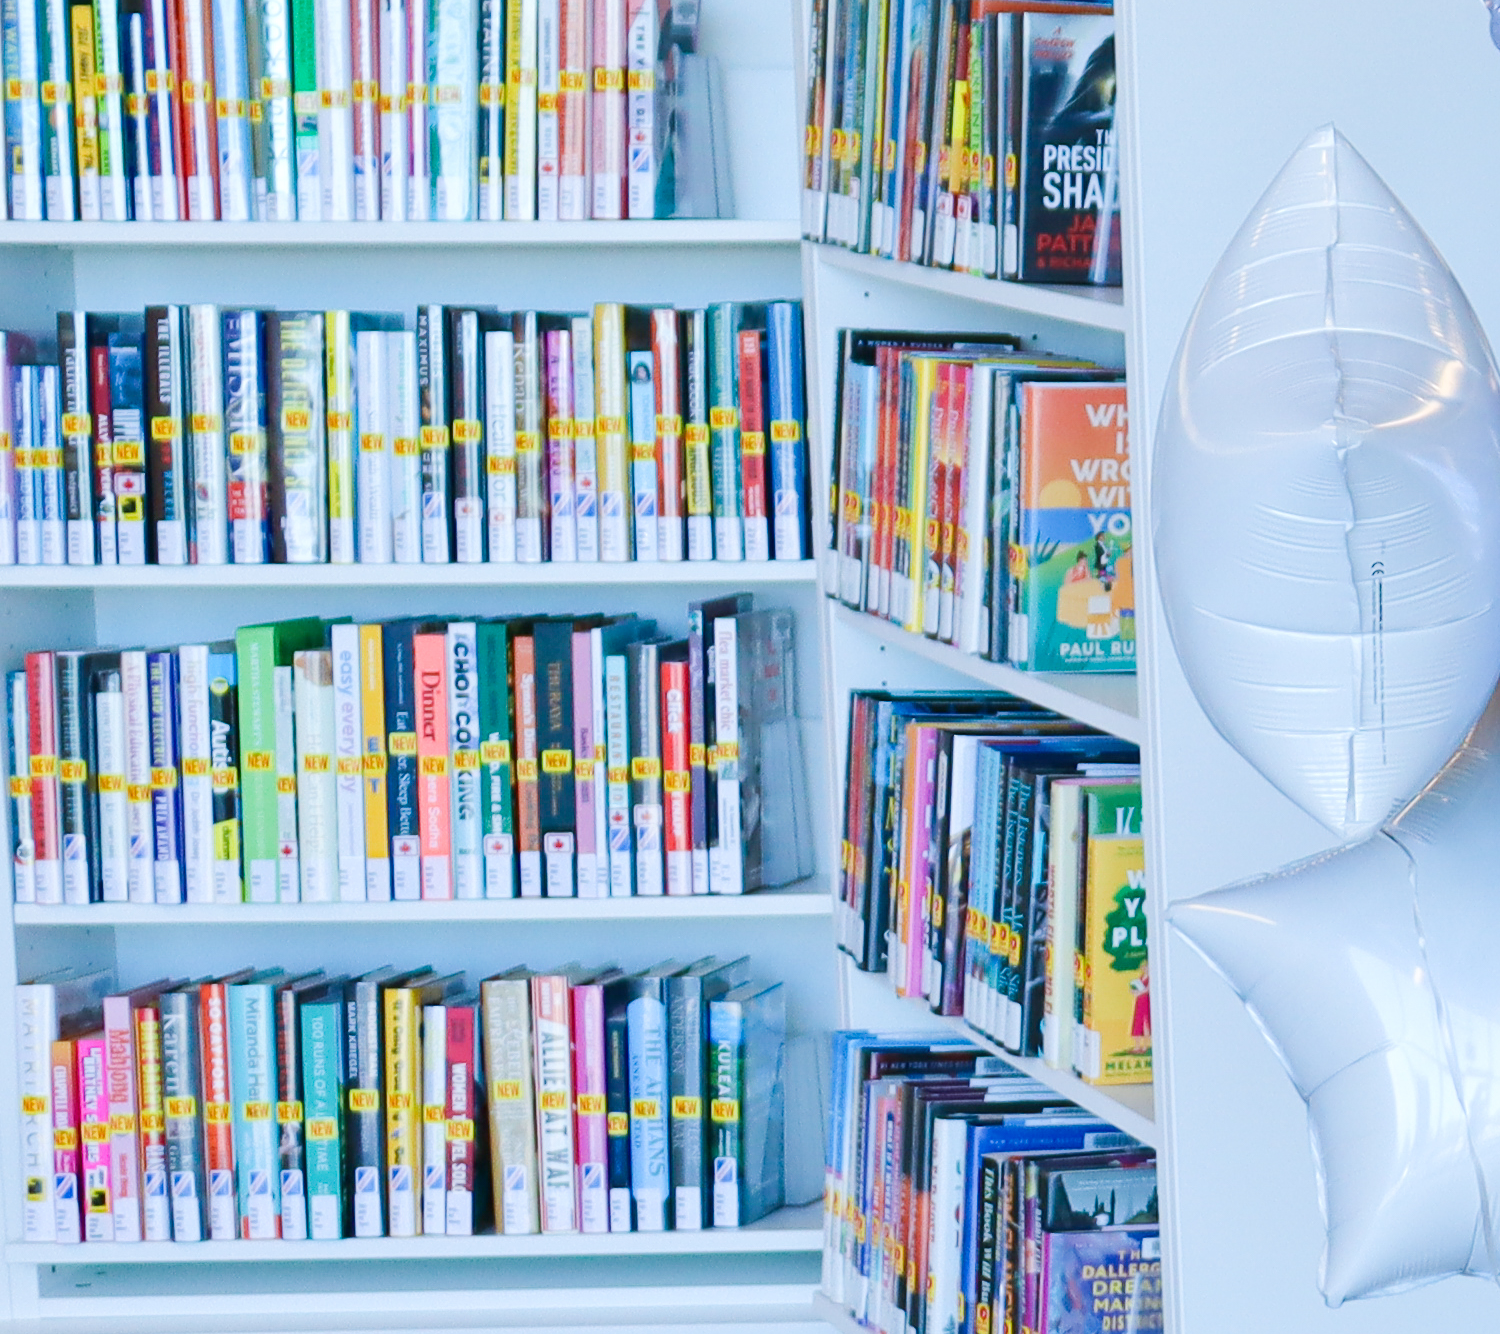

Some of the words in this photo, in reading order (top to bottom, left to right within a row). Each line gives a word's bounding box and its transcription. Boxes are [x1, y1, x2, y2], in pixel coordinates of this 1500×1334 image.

[1042, 144, 1113, 171] PRESID
[1042, 171, 1104, 209] SHA
[158, 318, 169, 341] THE
[419, 314, 431, 388] MAXIMUS
[65, 417, 88, 432] NEW
[194, 416, 218, 431] NEW
[286, 412, 309, 427] NEW
[599, 418, 622, 432] NEW
[1085, 403, 1130, 428] WH
[455, 423, 477, 438] NEW
[550, 421, 572, 436] NEW
[687, 427, 709, 442] NEW
[361, 434, 383, 449] NEW
[394, 439, 416, 454] NEW
[743, 434, 764, 450] NEW
[16, 451, 38, 466] NEW
[39, 451, 61, 465] NEW
[116, 444, 140, 459] NEW
[635, 445, 654, 459] NEW
[1070, 458, 1131, 483] WRO
[1087, 485, 1131, 509] WIT
[1088, 512, 1132, 537] YO
[718, 630, 734, 655] flea
[1058, 641, 1105, 657] PAUL
[149, 662, 161, 681] THE
[338, 650, 360, 696] easy
[453, 642, 469, 699] CHOI
[719, 658, 736, 703] market
[150, 684, 162, 713] MIND
[520, 673, 535, 725] Symon's
[546, 661, 562, 731] THURAYA
[420, 670, 442, 742] Dinner
[666, 688, 685, 734] Click
[395, 711, 409, 730] Eat
[608, 674, 625, 761] RESTAURAN
[719, 706, 736, 732] chic
[337, 702, 361, 793] everyay
[393, 735, 416, 750] NEW
[717, 744, 739, 758] NEW
[32, 758, 54, 773] NEW
[185, 759, 208, 774] NEW
[305, 755, 329, 770] NEW
[338, 759, 360, 773] NEW
[455, 752, 477, 767] NEW
[546, 753, 568, 768] NEW
[635, 759, 658, 775] NEW
[100, 776, 123, 791] NEW
[152, 770, 175, 785] NEW
[609, 768, 628, 783] NEW
[666, 773, 688, 788] NEW
[396, 773, 413, 805] Sleep
[154, 795, 167, 823] PRIA
[426, 807, 440, 849] Sodha
[208, 997, 223, 1019] SO
[347, 1001, 357, 1032] MARK
[244, 997, 263, 1069] Miranda
[312, 1016, 324, 1039] 100
[162, 1012, 186, 1092] Karen
[644, 1025, 663, 1065] THE
[107, 1028, 130, 1103] Mahjong
[314, 1041, 326, 1076] RUNS
[541, 1031, 566, 1091] ALLIE
[716, 1038, 732, 1101] KULEA
[22, 997, 41, 1168] MATRIRCH
[82, 1056, 98, 1111] BRITNEY
[450, 1062, 466, 1111] WOMEN
[23, 1098, 46, 1113] NEW
[170, 1101, 193, 1116] NEW
[353, 1091, 375, 1107] NEW
[580, 1096, 603, 1112] NEW
[635, 1101, 658, 1116] NEW
[207, 1106, 229, 1121] NEW
[278, 1105, 301, 1120] NEW
[426, 1107, 445, 1122] NEW
[714, 1104, 736, 1119] NEW
[111, 1116, 134, 1132] NEW
[448, 1123, 470, 1138] NEW
[544, 1110, 567, 1136] AT
[645, 1075, 665, 1178] AFHANS
[451, 1113, 467, 1160] TVEL
[981, 1202, 995, 1244] Book
[1081, 1263, 1161, 1281] DALLERG
